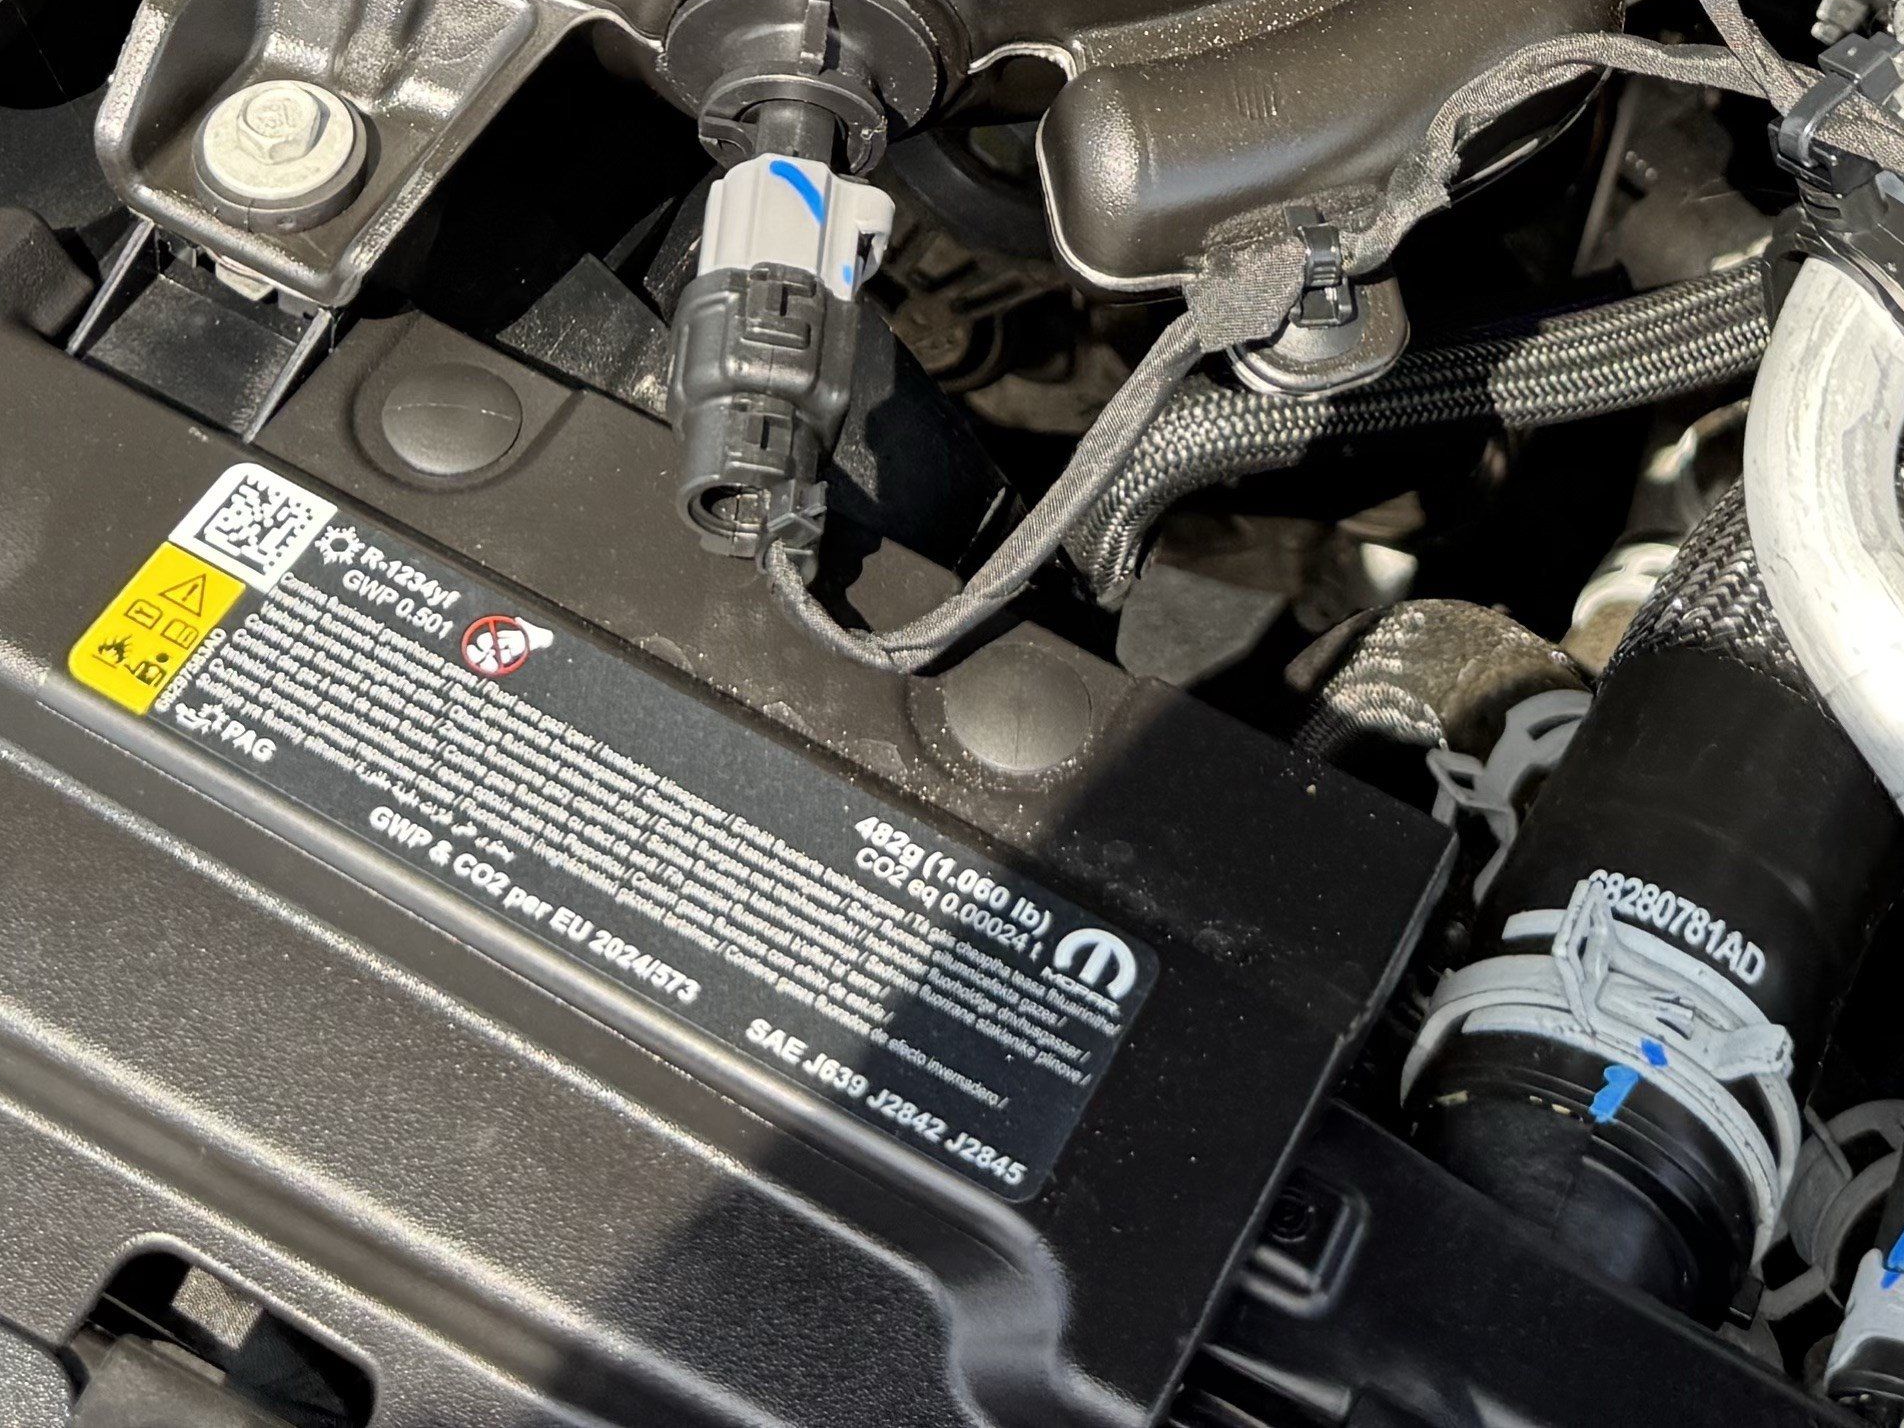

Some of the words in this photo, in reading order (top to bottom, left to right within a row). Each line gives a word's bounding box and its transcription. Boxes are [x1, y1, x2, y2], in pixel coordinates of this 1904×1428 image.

[342, 569, 399, 605] GWP
[395, 598, 454, 639] 0.501
[360, 547, 460, 608] R-1234yf
[221, 720, 276, 762] PAG
[369, 806, 433, 848] GWP
[428, 840, 453, 866] &
[453, 853, 510, 896] CO2
[503, 886, 553, 920] per
[549, 907, 594, 942] EU
[589, 930, 700, 1003] 2024/573
[855, 817, 925, 870] 482g
[922, 852, 1009, 909] (1.060
[1010, 897, 1051, 936] lb)
[855, 847, 912, 888] CO2
[907, 879, 940, 909] eq
[939, 892, 1029, 951] 0.00024
[746, 1019, 807, 1064] SAE
[802, 1053, 867, 1096] J639
[867, 1090, 946, 1142] J2842
[945, 1133, 1026, 1185] J2845
